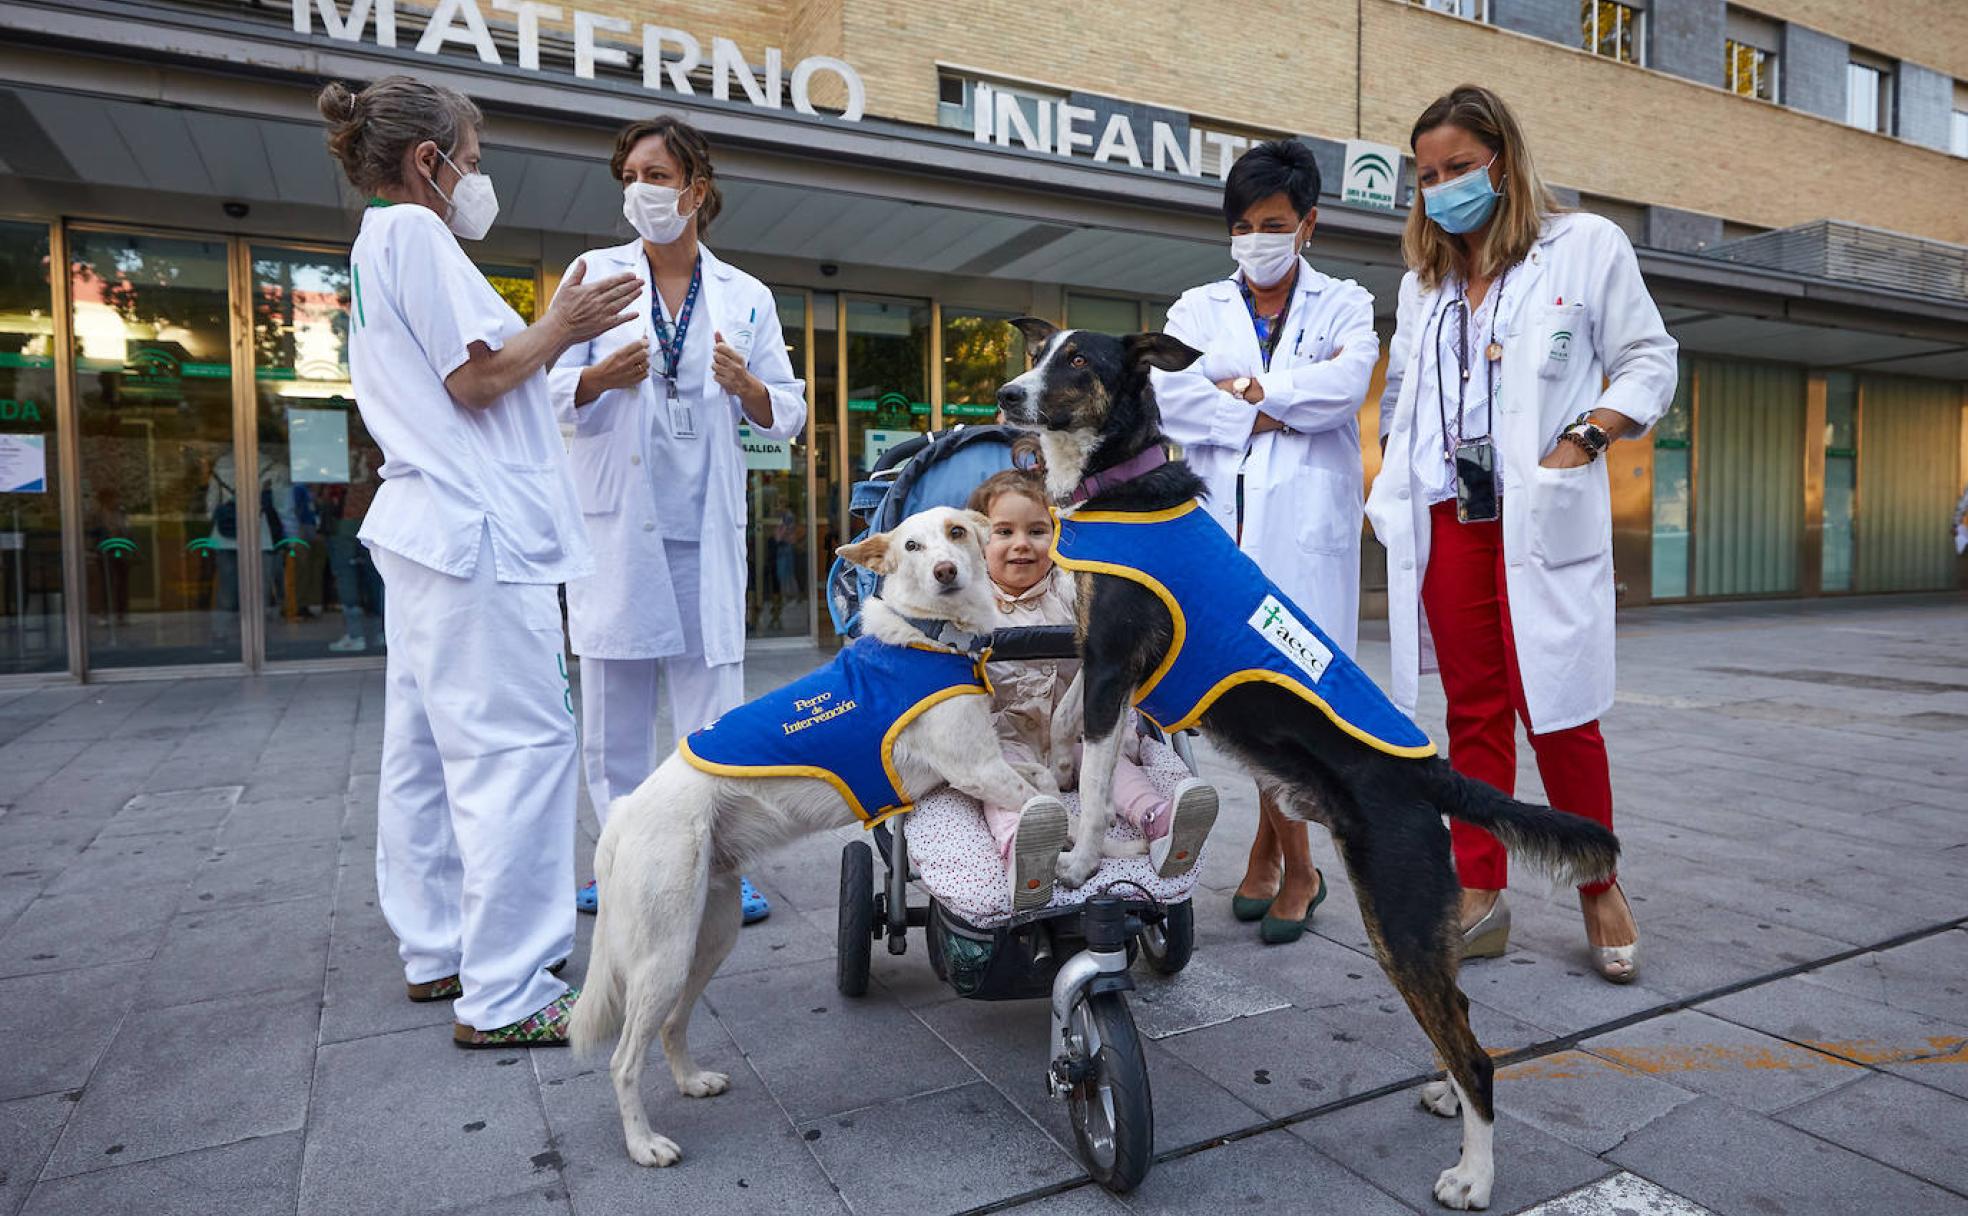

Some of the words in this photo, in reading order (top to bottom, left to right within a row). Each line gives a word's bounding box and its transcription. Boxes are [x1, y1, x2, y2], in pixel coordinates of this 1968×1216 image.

[291, 0, 866, 122] MATERNO
[973, 80, 1266, 183] INFANT
[1276, 626, 1323, 672] aecc
[782, 700, 857, 736] Intervención
[793, 692, 832, 712] Perro
[811, 706, 824, 715] de
